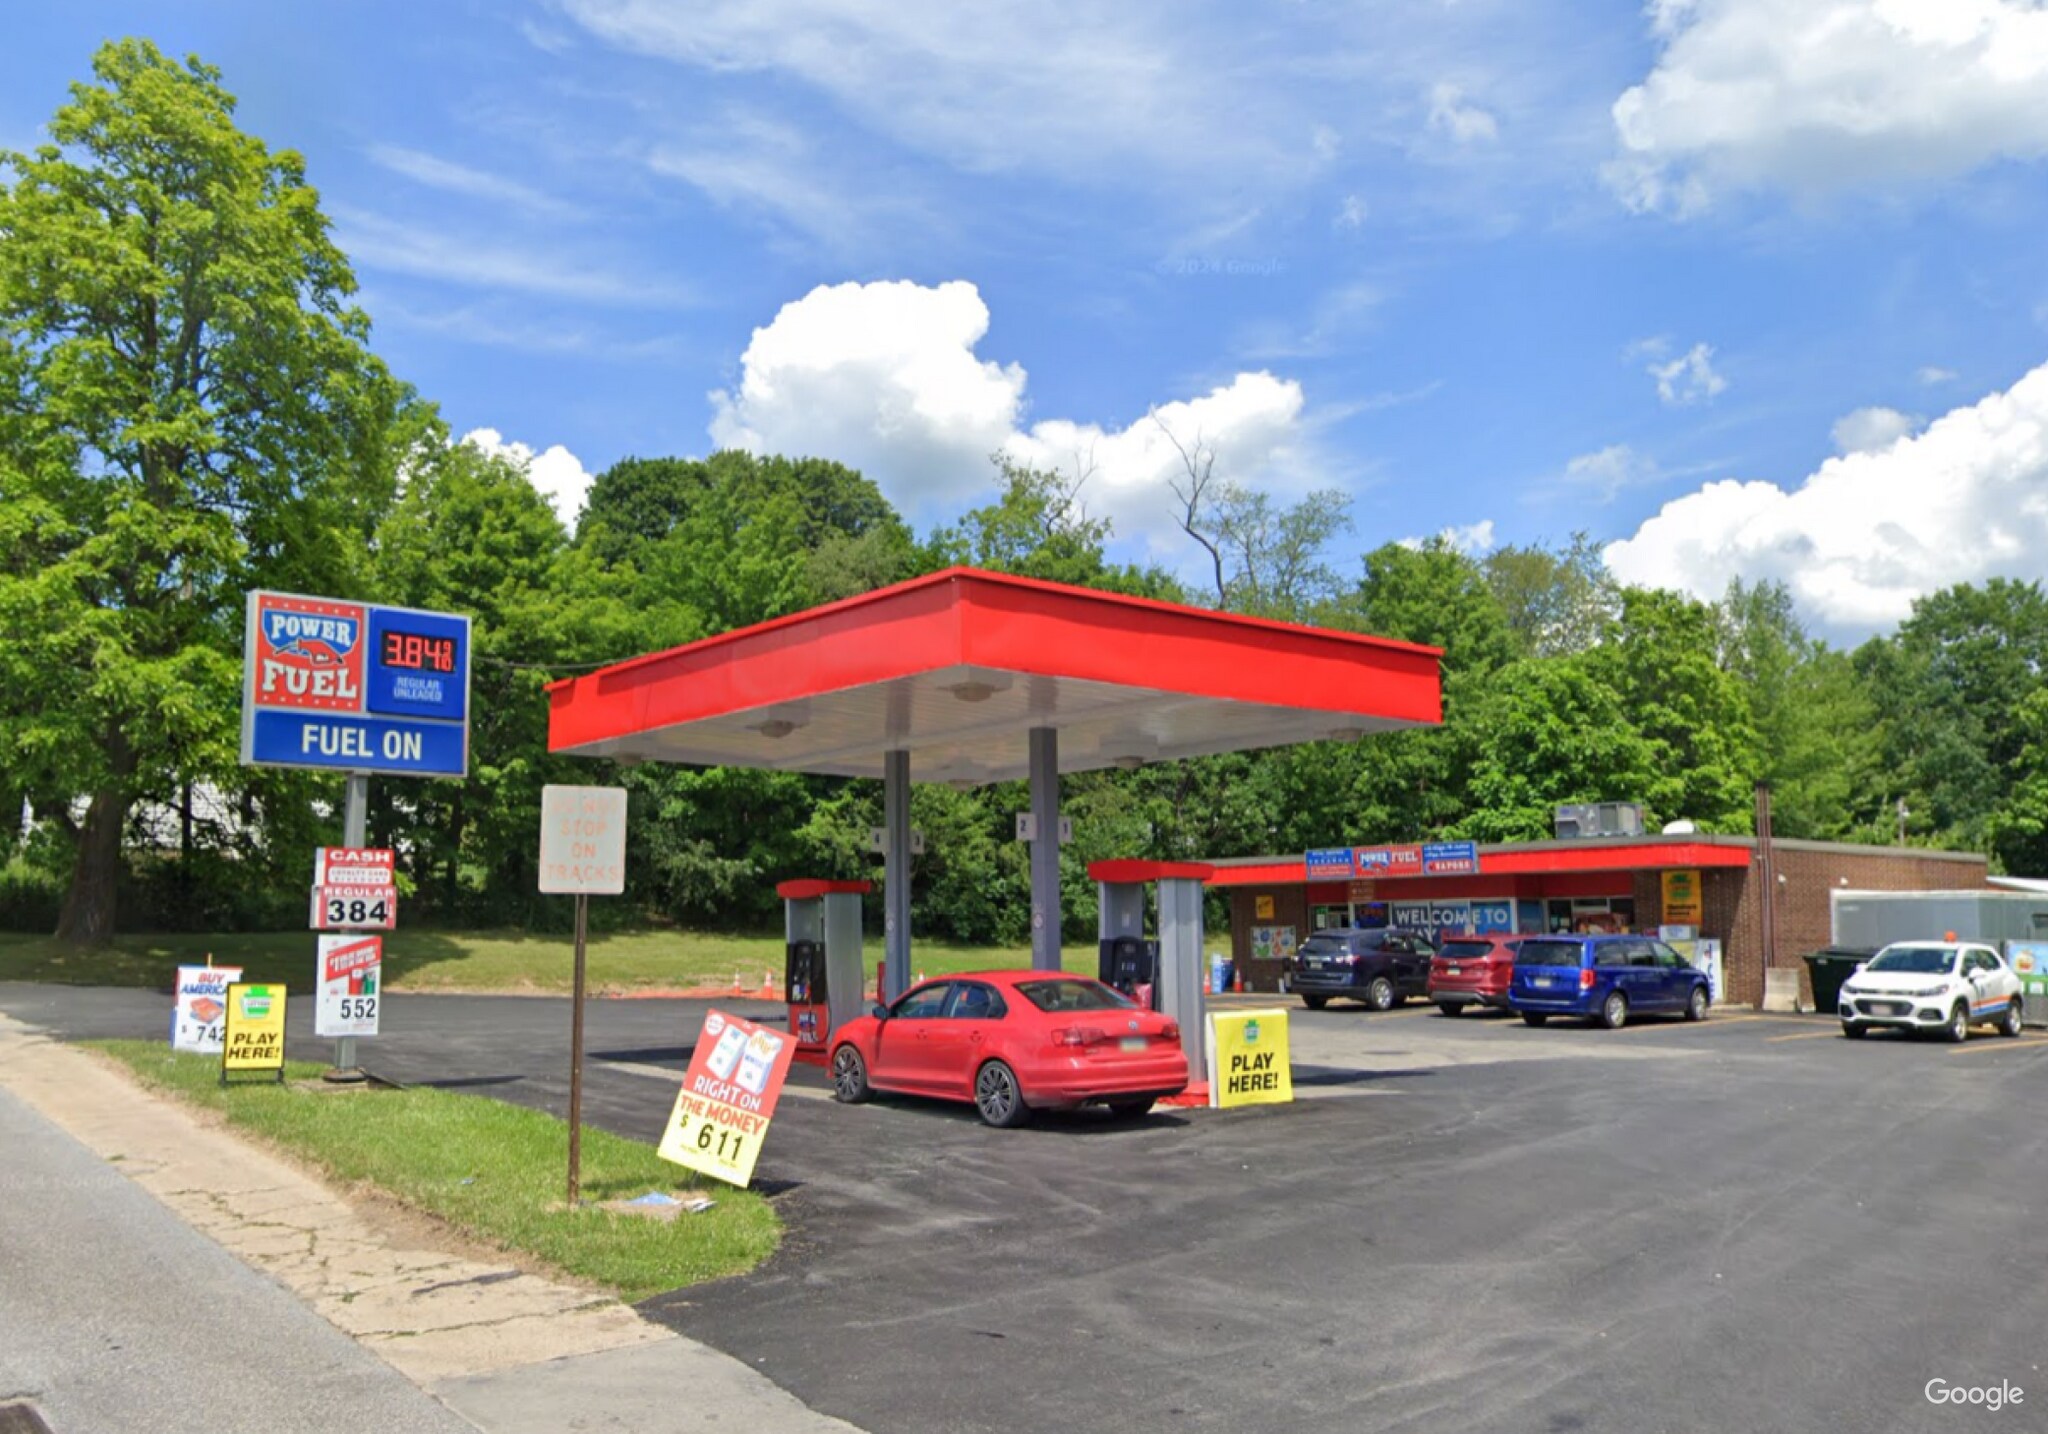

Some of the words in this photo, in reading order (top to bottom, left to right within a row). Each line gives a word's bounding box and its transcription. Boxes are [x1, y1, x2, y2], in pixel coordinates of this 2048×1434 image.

[271, 614, 350, 646] POWER
[262, 659, 357, 699] FUEL
[397, 677, 440, 690] REGULAR
[393, 686, 443, 702] UNLEADED
[302, 724, 374, 757] FUEL
[383, 730, 421, 760] ON
[560, 818, 608, 837] STOP
[1020, 819, 1026, 832] 2
[329, 850, 390, 863] CASH
[571, 842, 597, 859] ON
[1391, 850, 1418, 863] FUEL
[547, 864, 618, 882] TRACKS
[324, 887, 394, 897] REGULAR
[327, 899, 388, 923] 384
[1396, 908, 1481, 926] WELCOME
[1484, 908, 1507, 924] TO
[198, 972, 225, 983] BUY
[341, 998, 376, 1020] 552
[233, 1032, 279, 1045] PLAY
[227, 1046, 280, 1060] HERE!
[1231, 1052, 1275, 1073] PLAY
[1228, 1073, 1279, 1094] HERE!
[694, 1075, 741, 1103] RIGHT
[741, 1095, 762, 1111] ON
[680, 1096, 704, 1116] THE
[706, 1104, 764, 1135] MONEY
[680, 1115, 689, 1128] $
[697, 1123, 743, 1161] 611
